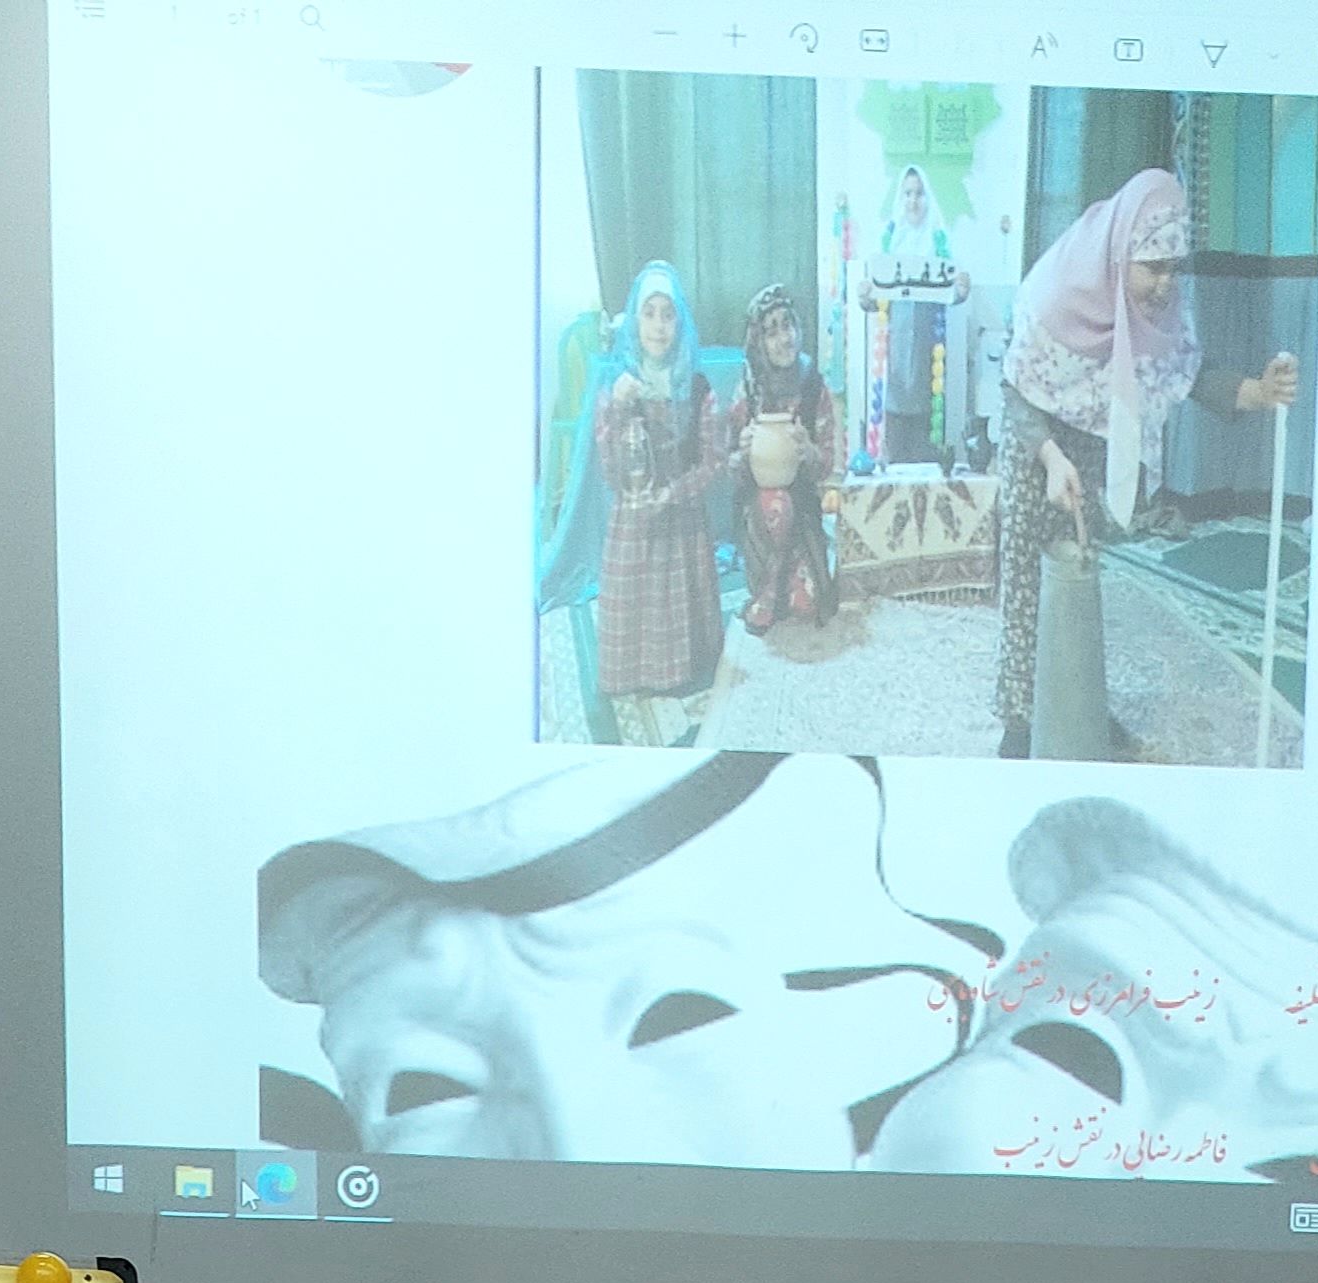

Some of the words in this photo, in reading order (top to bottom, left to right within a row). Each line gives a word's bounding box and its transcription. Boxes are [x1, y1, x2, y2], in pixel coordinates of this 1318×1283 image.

[999, 949, 1051, 1013] نقش
[1048, 985, 1066, 1005] در
[1153, 967, 1221, 1023] زینب
[993, 1115, 1058, 1169] زینب
[1057, 1106, 1107, 1169] نقش
[1105, 1141, 1122, 1161] در
[1185, 1130, 1228, 1164] فاطمه
